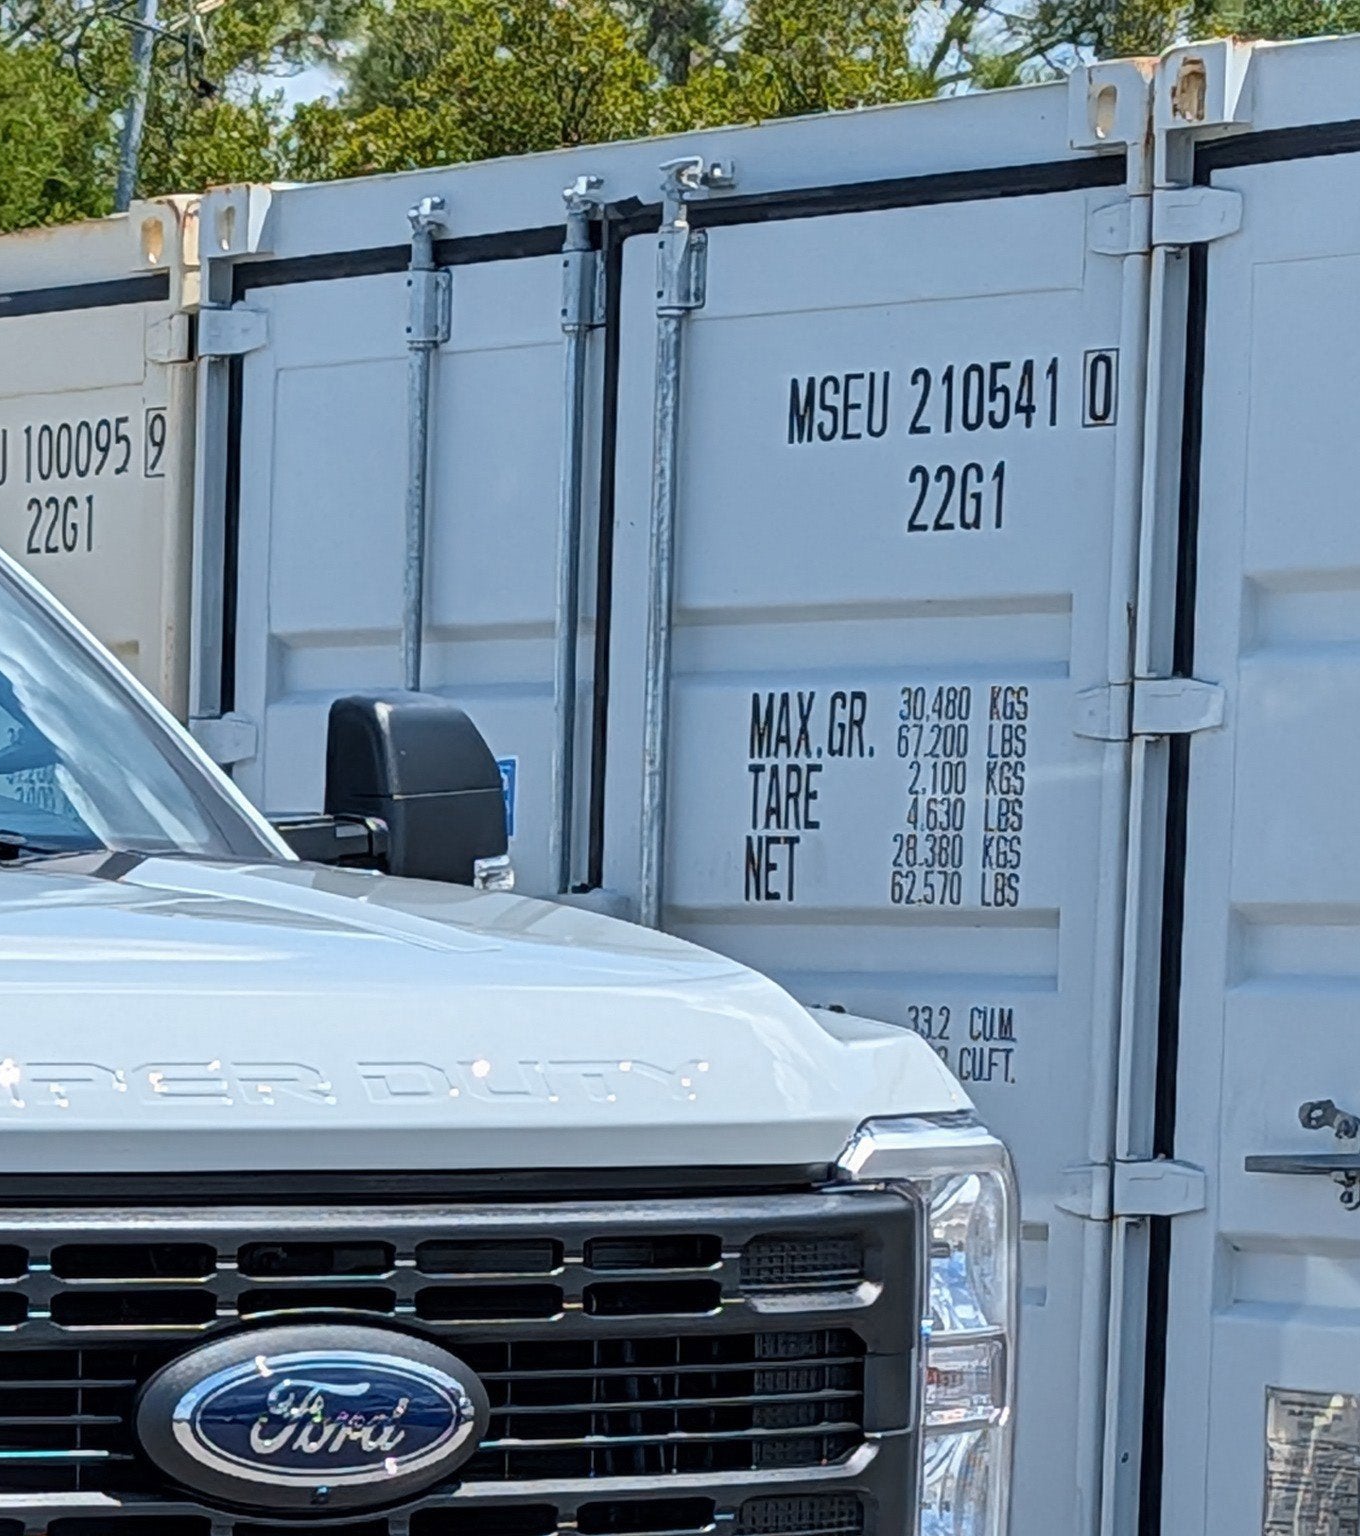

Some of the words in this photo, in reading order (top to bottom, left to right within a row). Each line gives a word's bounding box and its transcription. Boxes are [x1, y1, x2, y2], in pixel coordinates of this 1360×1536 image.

[787, 371, 890, 445] MSEU
[908, 356, 1059, 435] 210541
[1088, 353, 1113, 422] 0
[24, 416, 131, 484] 100095
[147, 410, 167, 473] 9
[26, 494, 95, 555] 22G1
[907, 460, 1006, 533] 22G1
[989, 685, 1029, 721] KGS
[986, 723, 1027, 759] LBS
[748, 764, 823, 831] TARE
[985, 761, 1026, 796] KGS
[983, 798, 1024, 832] LBS
[744, 835, 800, 902] NET
[982, 834, 1022, 869] KGS
[981, 871, 1020, 907] LBS
[355, 1057, 710, 1104] DUTY
[249, 1378, 409, 1455] Ford
